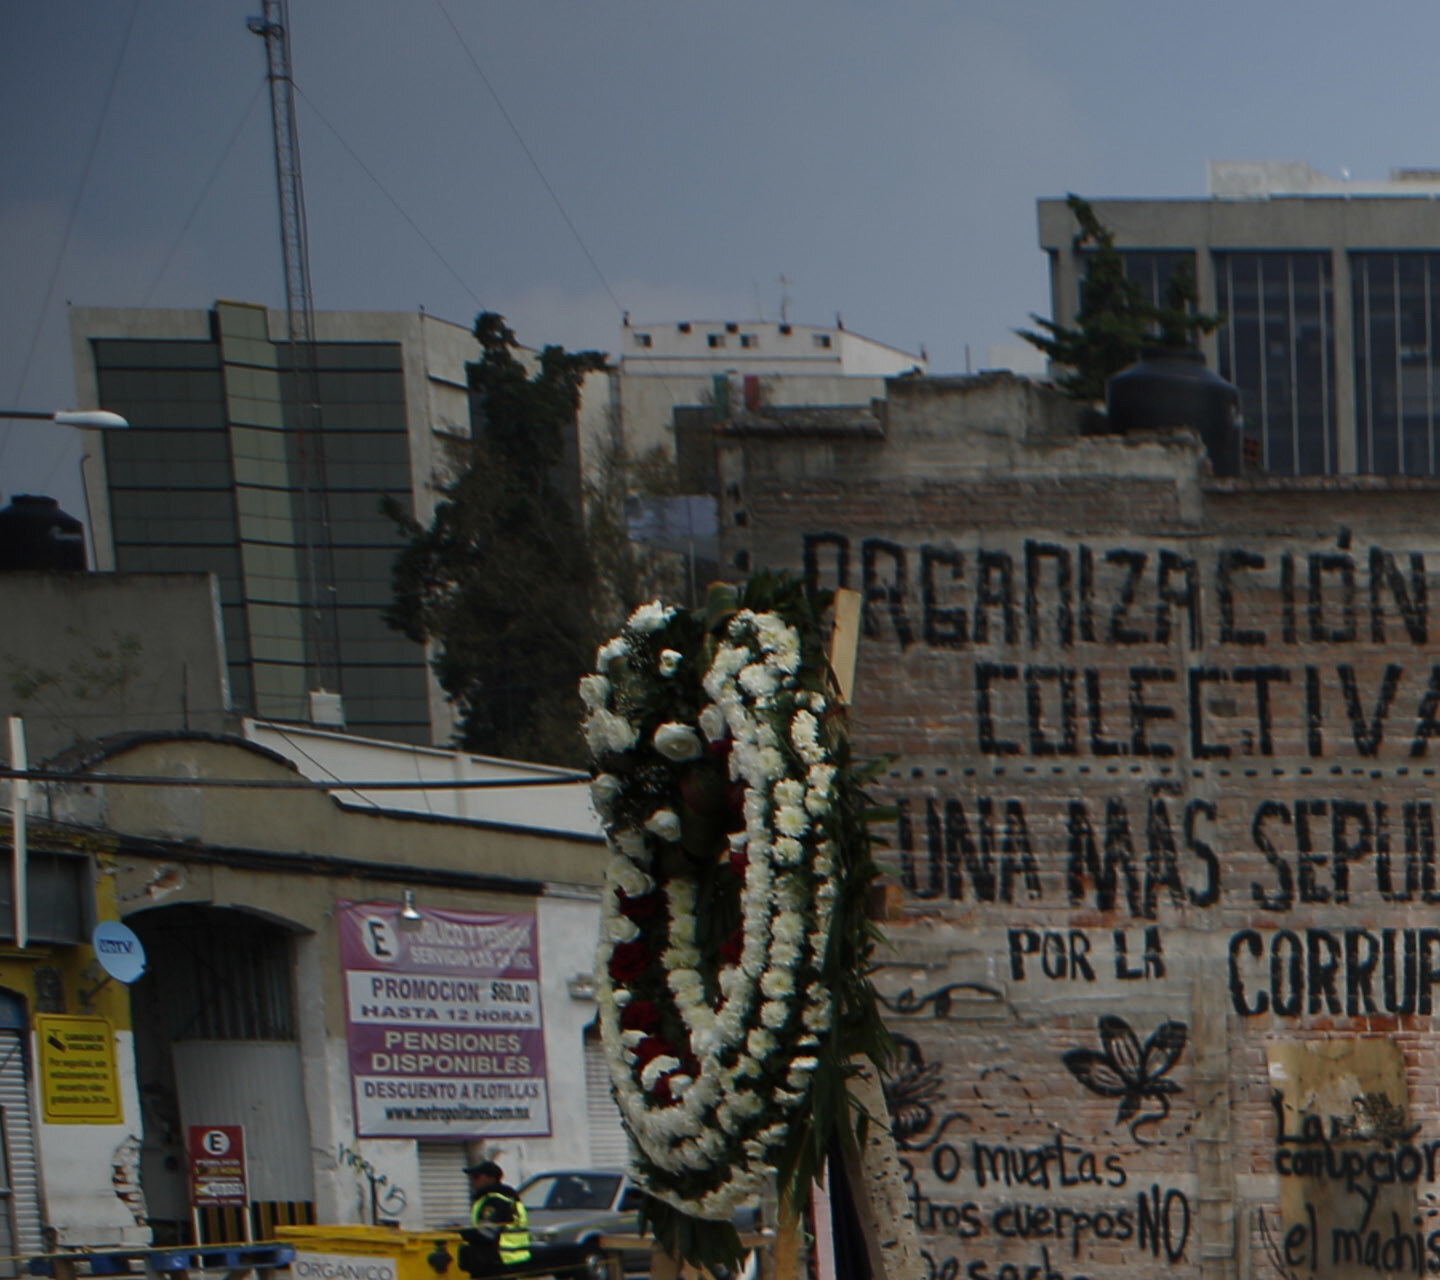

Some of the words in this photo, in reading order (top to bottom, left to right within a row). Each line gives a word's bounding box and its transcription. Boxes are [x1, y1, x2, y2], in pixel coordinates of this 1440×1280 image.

[803, 526, 1428, 649] ORGANIZACIÓN
[897, 798, 1043, 904] UNA
[1067, 782, 1221, 919] MÁS
[368, 920, 393, 956] E
[1008, 928, 1095, 983] POR
[1114, 926, 1165, 981] LA
[372, 977, 480, 1003] PROMOCION
[361, 1004, 440, 1021] HASTA
[447, 1008, 470, 1022] 12
[475, 1009, 534, 1023] HORAS
[384, 1030, 521, 1052] PENSIONES
[371, 1052, 531, 1074] DISPONIBLES
[364, 1080, 458, 1099] DESCUENTO
[461, 1082, 471, 1099] A
[210, 1133, 222, 1150] E
[971, 1132, 1128, 1189] muertas
[993, 1201, 1134, 1259] cuerpos
[1137, 1184, 1191, 1264] NO
[1284, 1202, 1318, 1272] el
